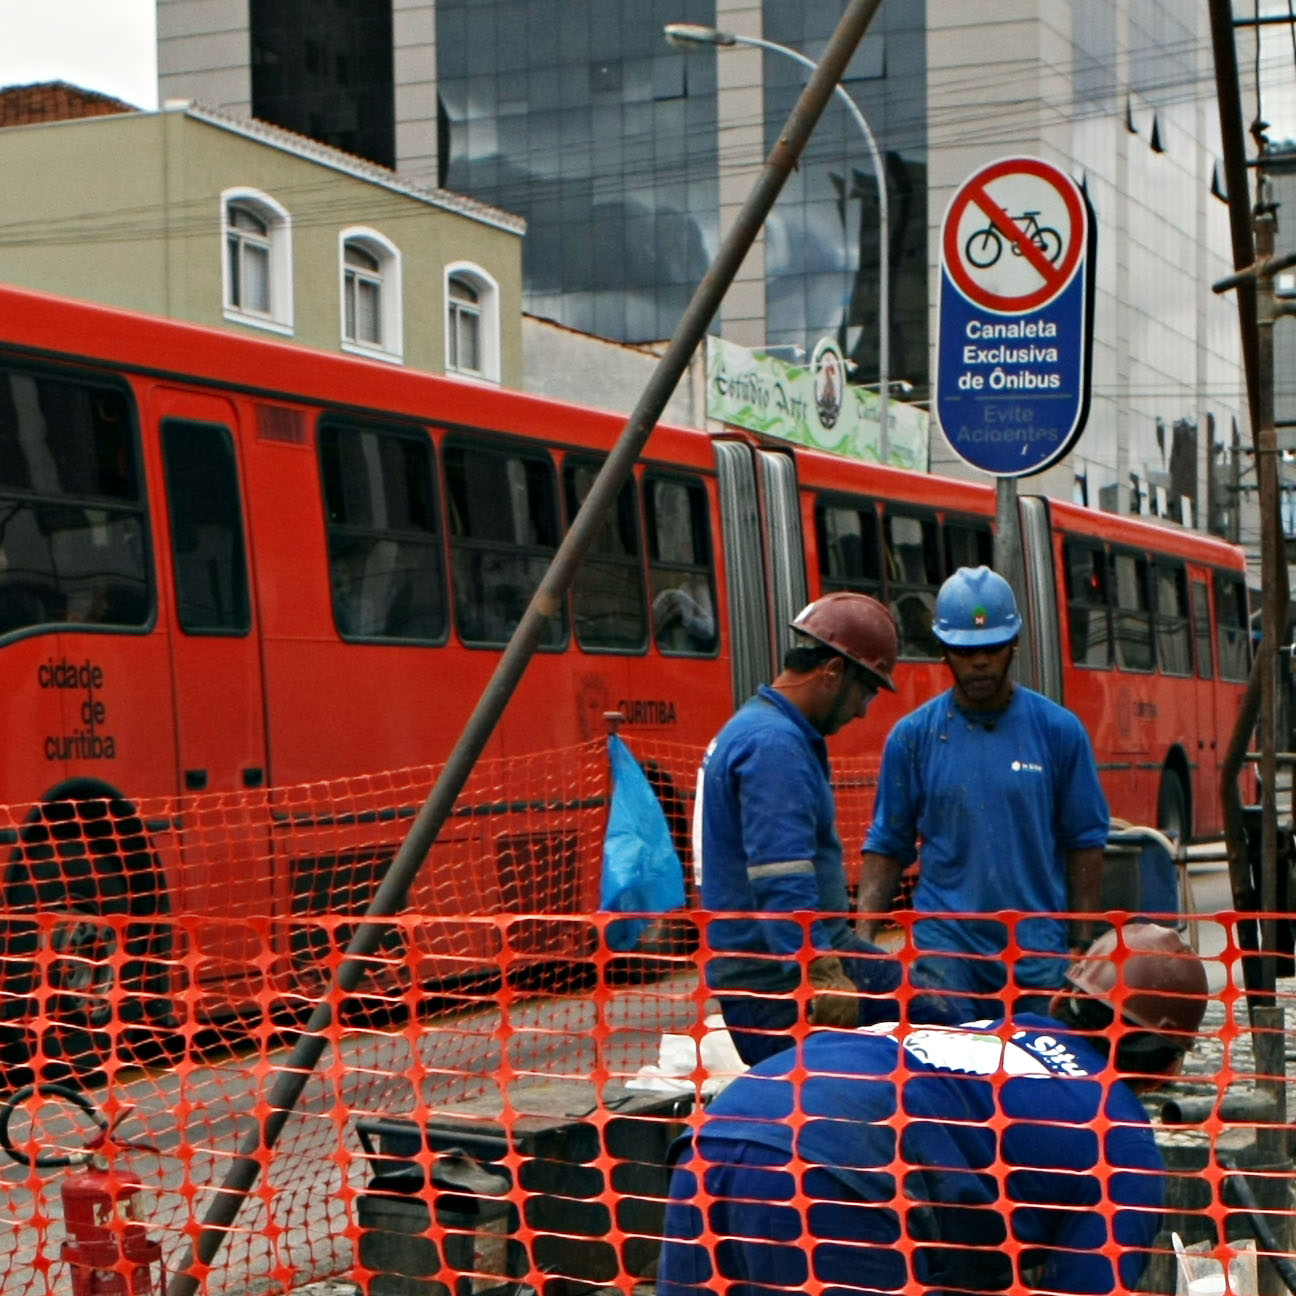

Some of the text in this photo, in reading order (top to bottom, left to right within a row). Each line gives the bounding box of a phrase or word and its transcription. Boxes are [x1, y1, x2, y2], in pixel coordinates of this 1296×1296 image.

[966, 319, 1057, 339] Canaleta
[962, 344, 1058, 364] Exclusiva
[958, 367, 1061, 390] de Ônibus
[983, 404, 1034, 423] Evite
[37, 655, 103, 689] cidade
[81, 691, 106, 726] de
[618, 700, 677, 725] CURITIBA
[44, 727, 116, 760] curitiba
